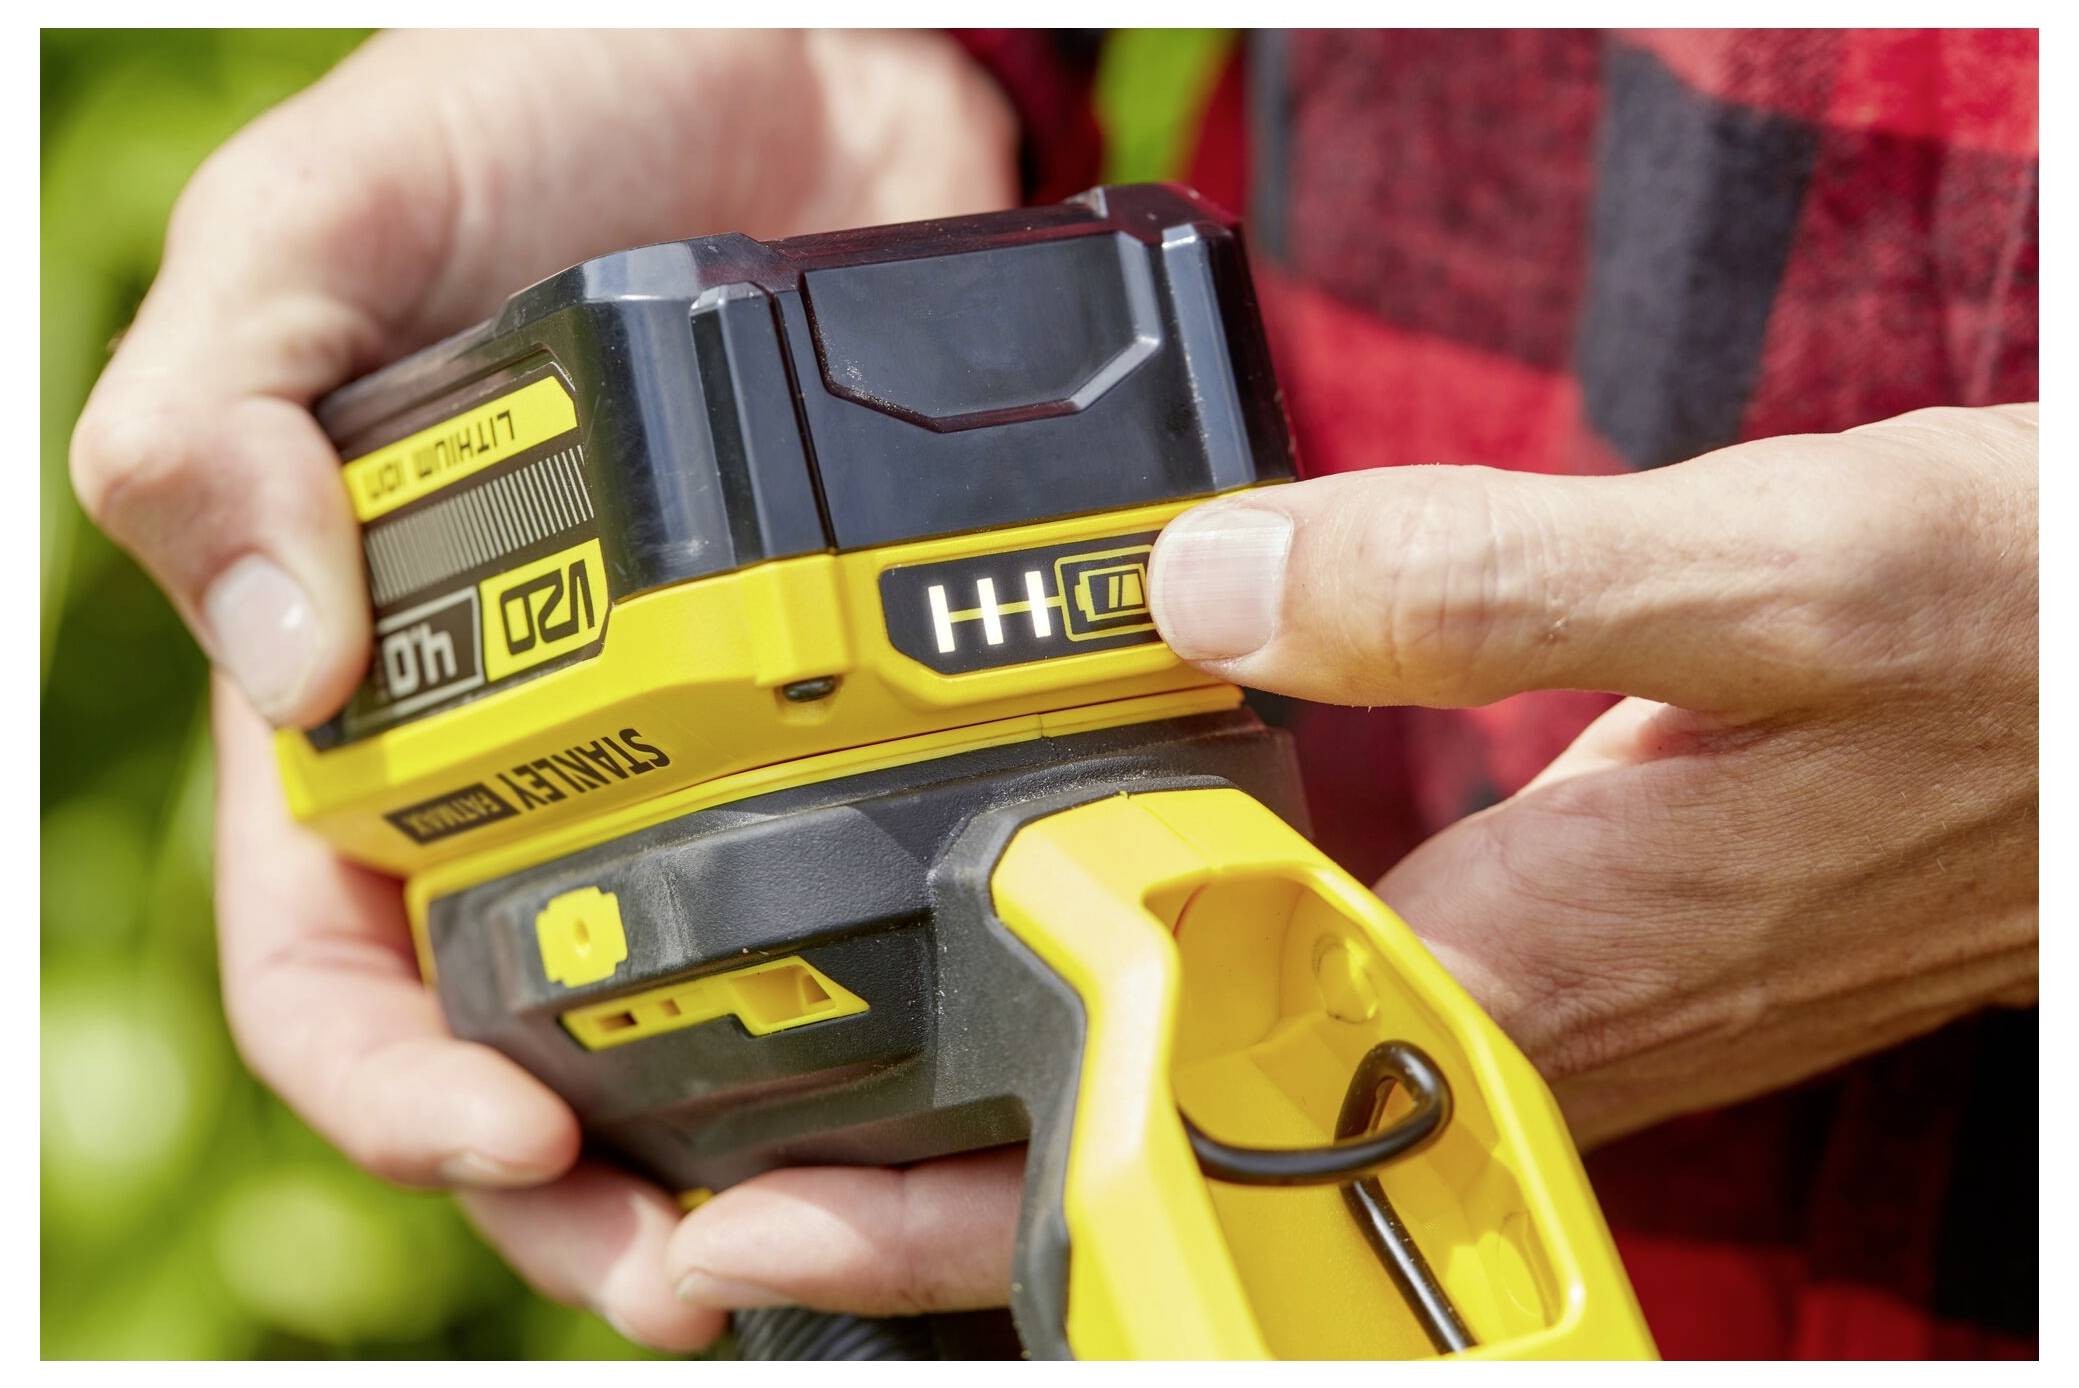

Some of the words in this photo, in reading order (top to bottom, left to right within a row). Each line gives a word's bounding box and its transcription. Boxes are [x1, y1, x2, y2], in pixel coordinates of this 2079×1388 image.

[416, 409, 516, 480] LITHIUM
[500, 558, 596, 656] V20
[383, 626, 457, 699] 4.0
[496, 728, 671, 810] STANLEY
[401, 791, 502, 838] FATMAX
